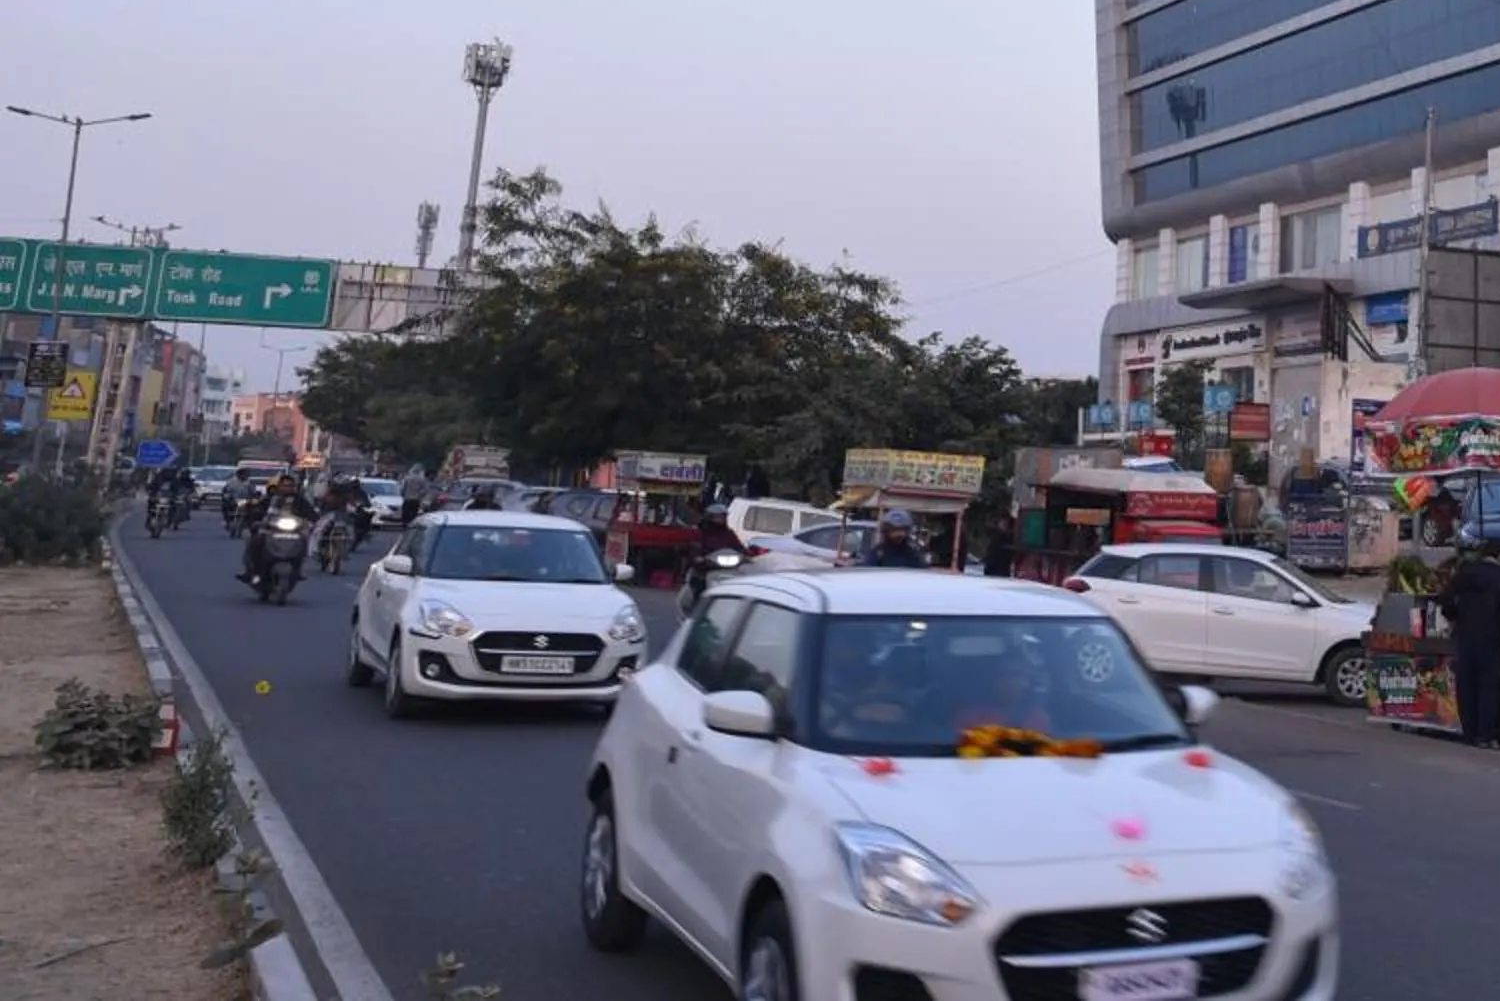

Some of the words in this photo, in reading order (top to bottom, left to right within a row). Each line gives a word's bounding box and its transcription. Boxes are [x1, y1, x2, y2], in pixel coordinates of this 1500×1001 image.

[82, 284, 116, 304] Marg
[167, 290, 196, 304] Tonk
[208, 292, 242, 307] Road
